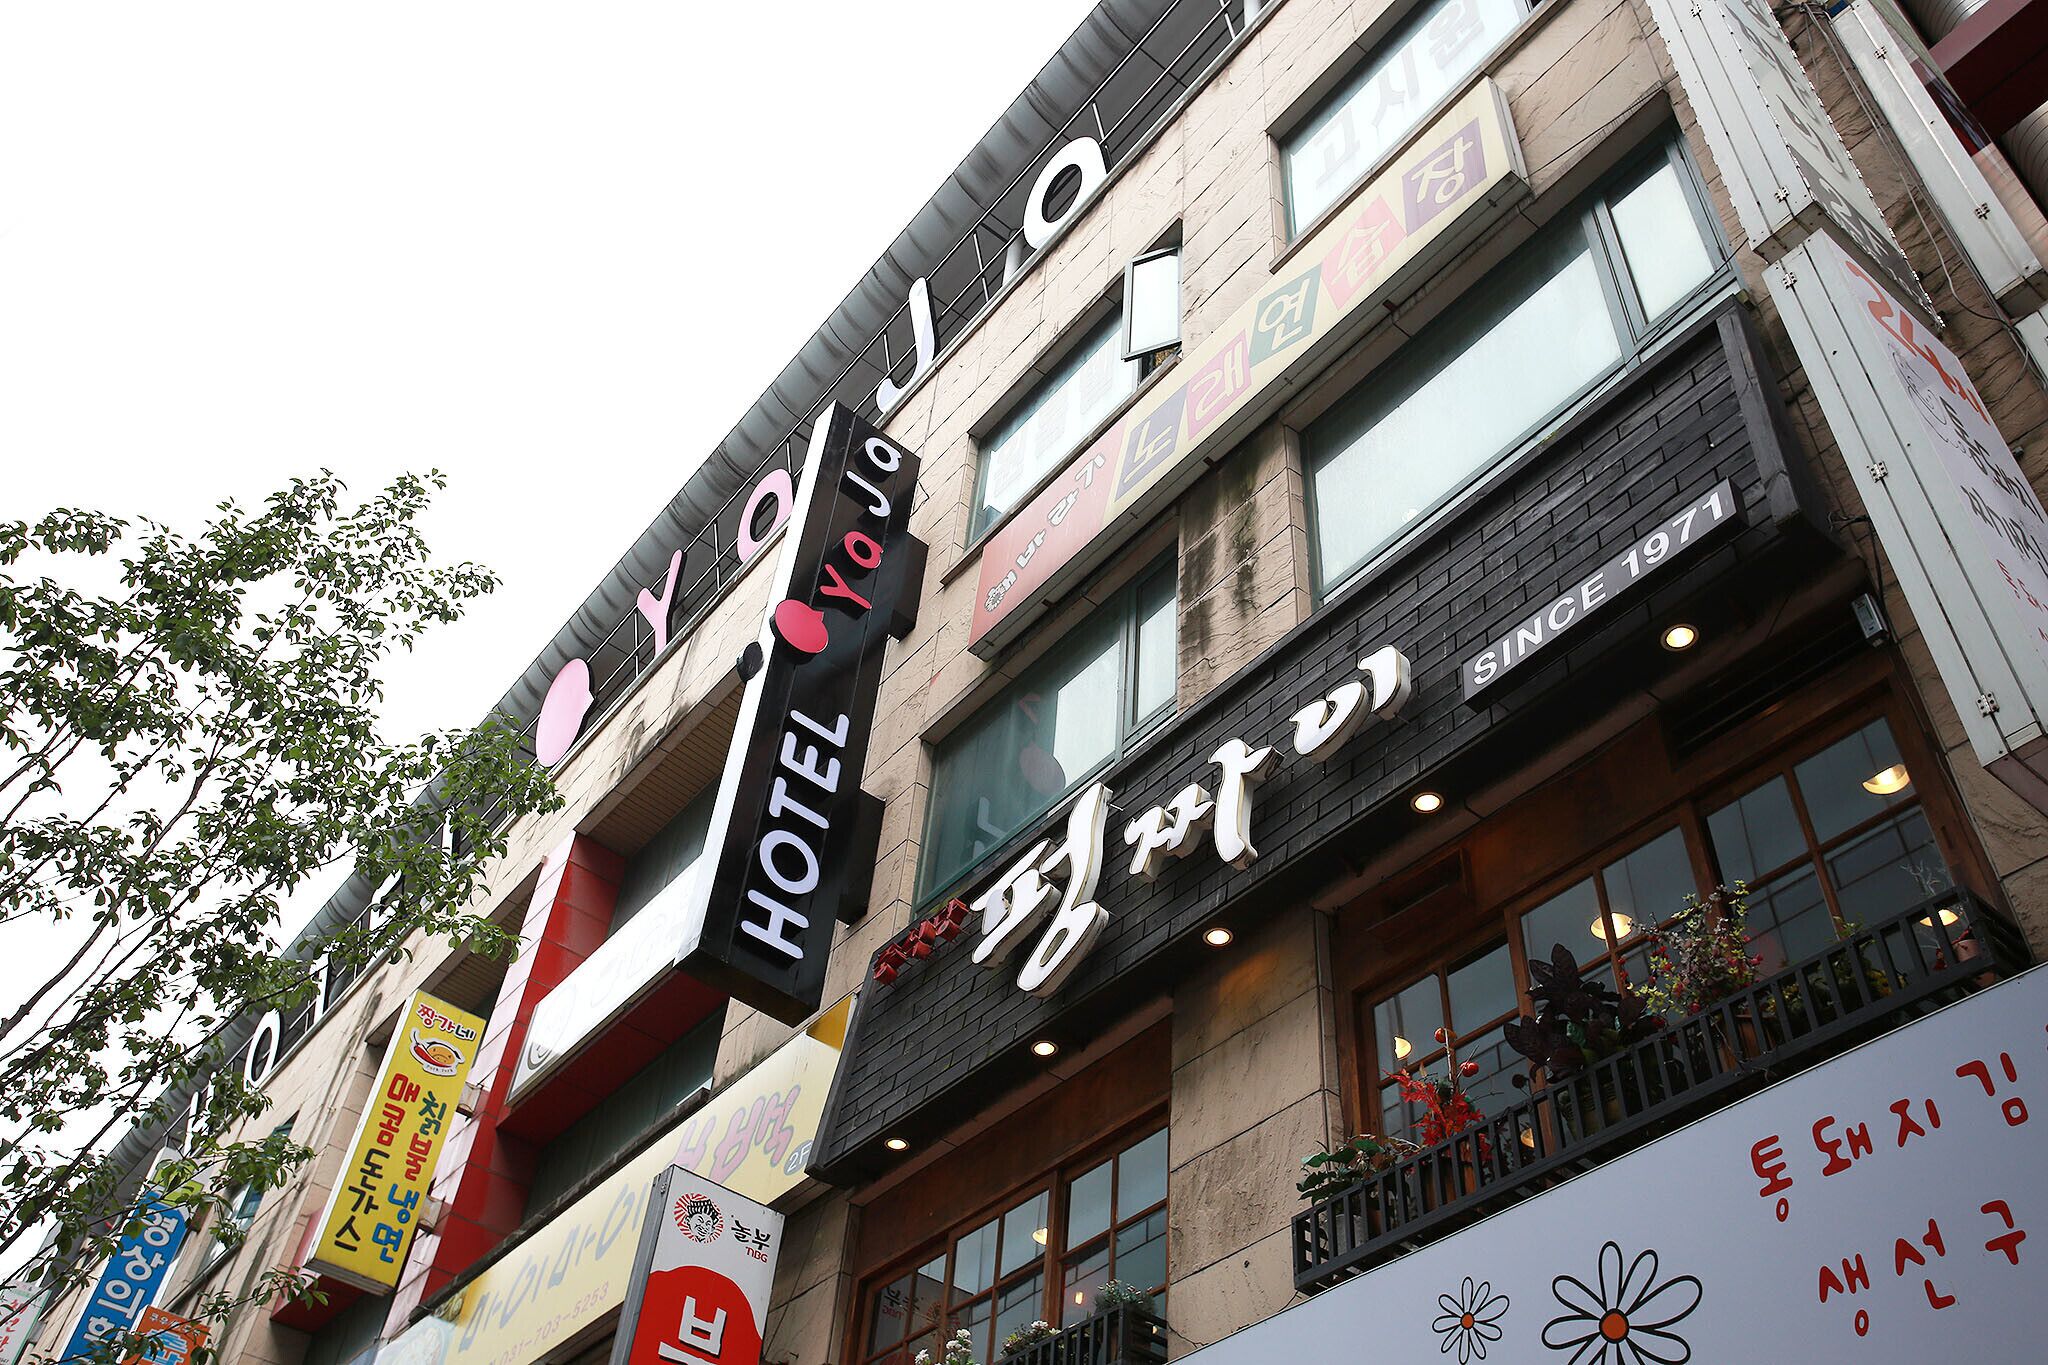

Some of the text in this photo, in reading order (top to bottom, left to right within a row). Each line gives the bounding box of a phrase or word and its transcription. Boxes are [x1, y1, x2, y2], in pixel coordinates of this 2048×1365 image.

[1105, 137, 1474, 483] 노래연습장
[1473, 491, 1723, 686] SINCE 1971
[741, 709, 850, 960] HOTEL
[334, 1073, 421, 1252] 매콤돈가스
[371, 1090, 447, 1264] 칡불냉면
[731, 1218, 772, 1250] 놀부
[1817, 1199, 2028, 1338] 생선구
